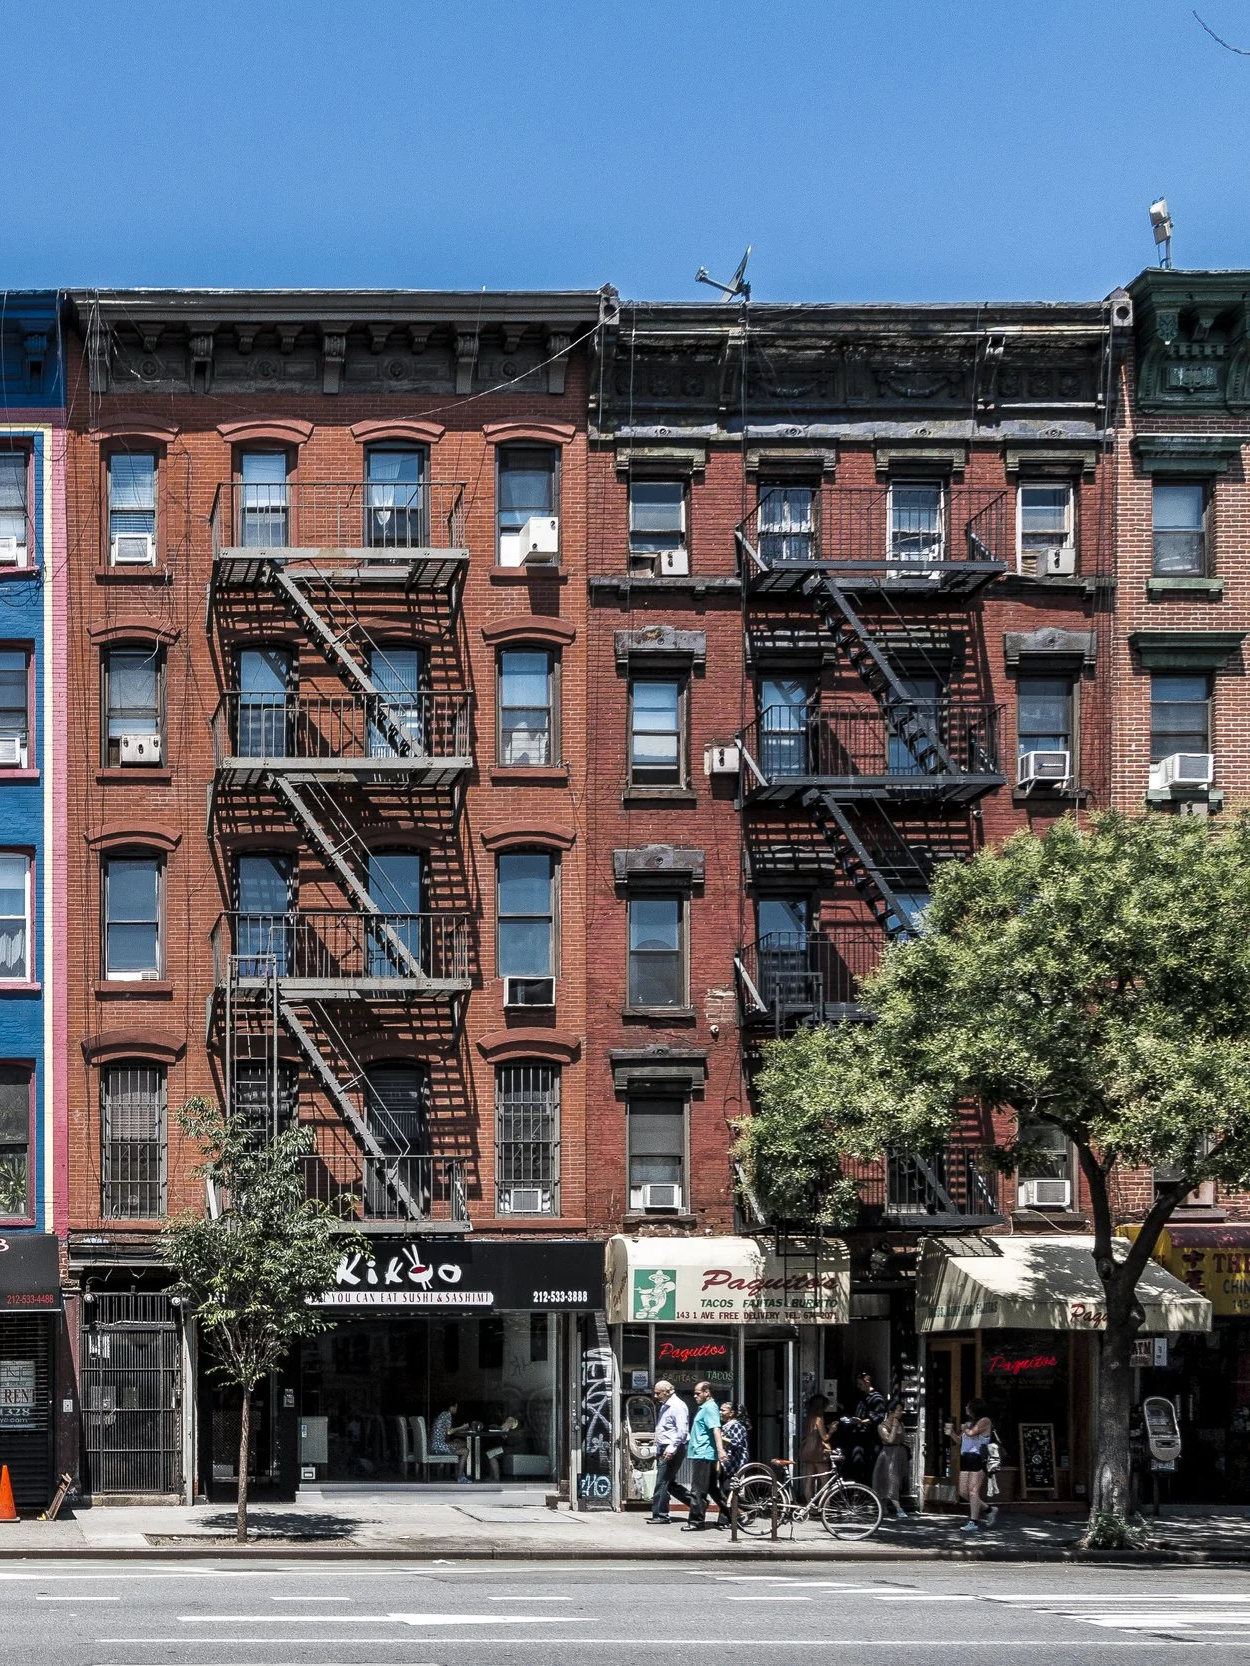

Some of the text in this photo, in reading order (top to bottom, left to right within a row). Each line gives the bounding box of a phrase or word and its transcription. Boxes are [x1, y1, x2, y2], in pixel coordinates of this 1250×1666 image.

[6, 1294, 54, 1304] 212-533-4488
[331, 1292, 352, 1303] YOU
[356, 1292, 375, 1303] CAN
[380, 1292, 398, 1303] EAT
[402, 1292, 433, 1303] SUSHI
[436, 1293, 444, 1302] &
[445, 1291, 490, 1303] SASHIMI
[533, 1291, 588, 1303] 212-533-3888
[700, 1299, 734, 1308] TACOS
[742, 1299, 783, 1308] FAJITAS
[700, 1311, 715, 1320] AVE
[719, 1311, 740, 1320] FREE
[743, 1311, 780, 1320] DELIVERY
[658, 1342, 726, 1363] Paquitos
[706, 1370, 734, 1381] TACOS
